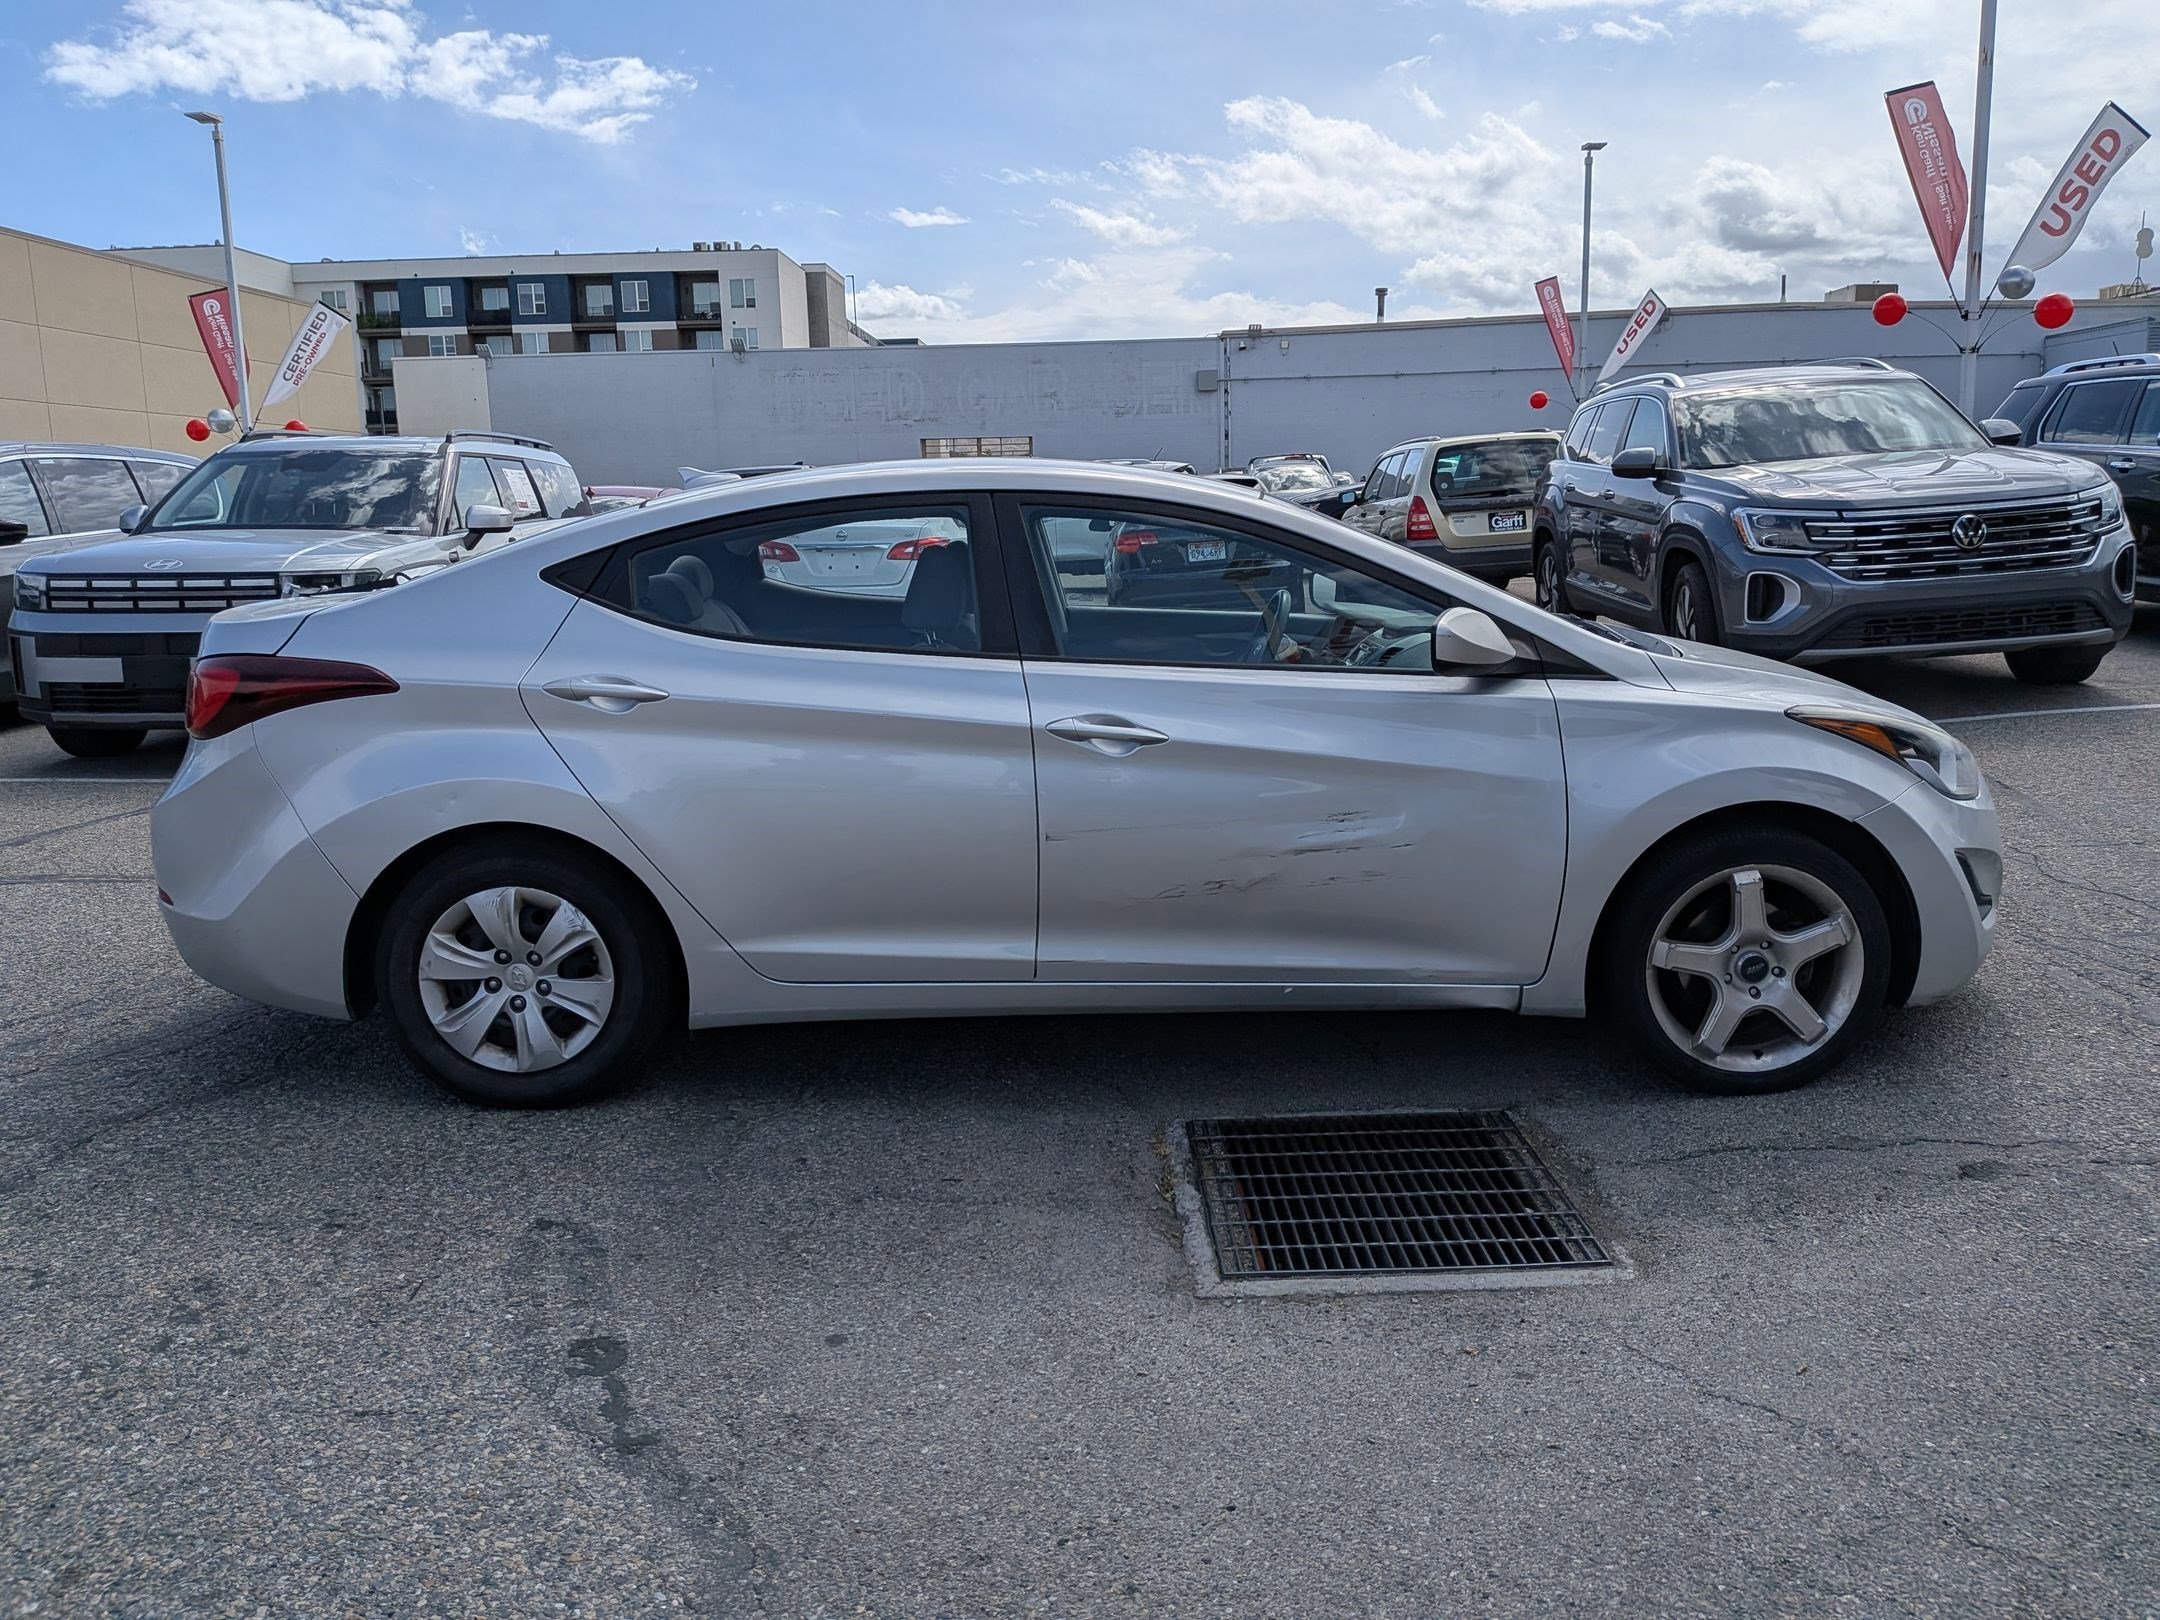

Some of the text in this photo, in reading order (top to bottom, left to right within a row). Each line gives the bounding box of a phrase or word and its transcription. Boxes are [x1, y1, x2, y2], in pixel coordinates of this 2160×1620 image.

[2040, 129, 2121, 237] USED
[282, 311, 328, 382] CERTIFIED
[1616, 299, 1657, 355] USED
[293, 332, 327, 386] PRE-OWNED
[1491, 514, 1524, 528] Garff
